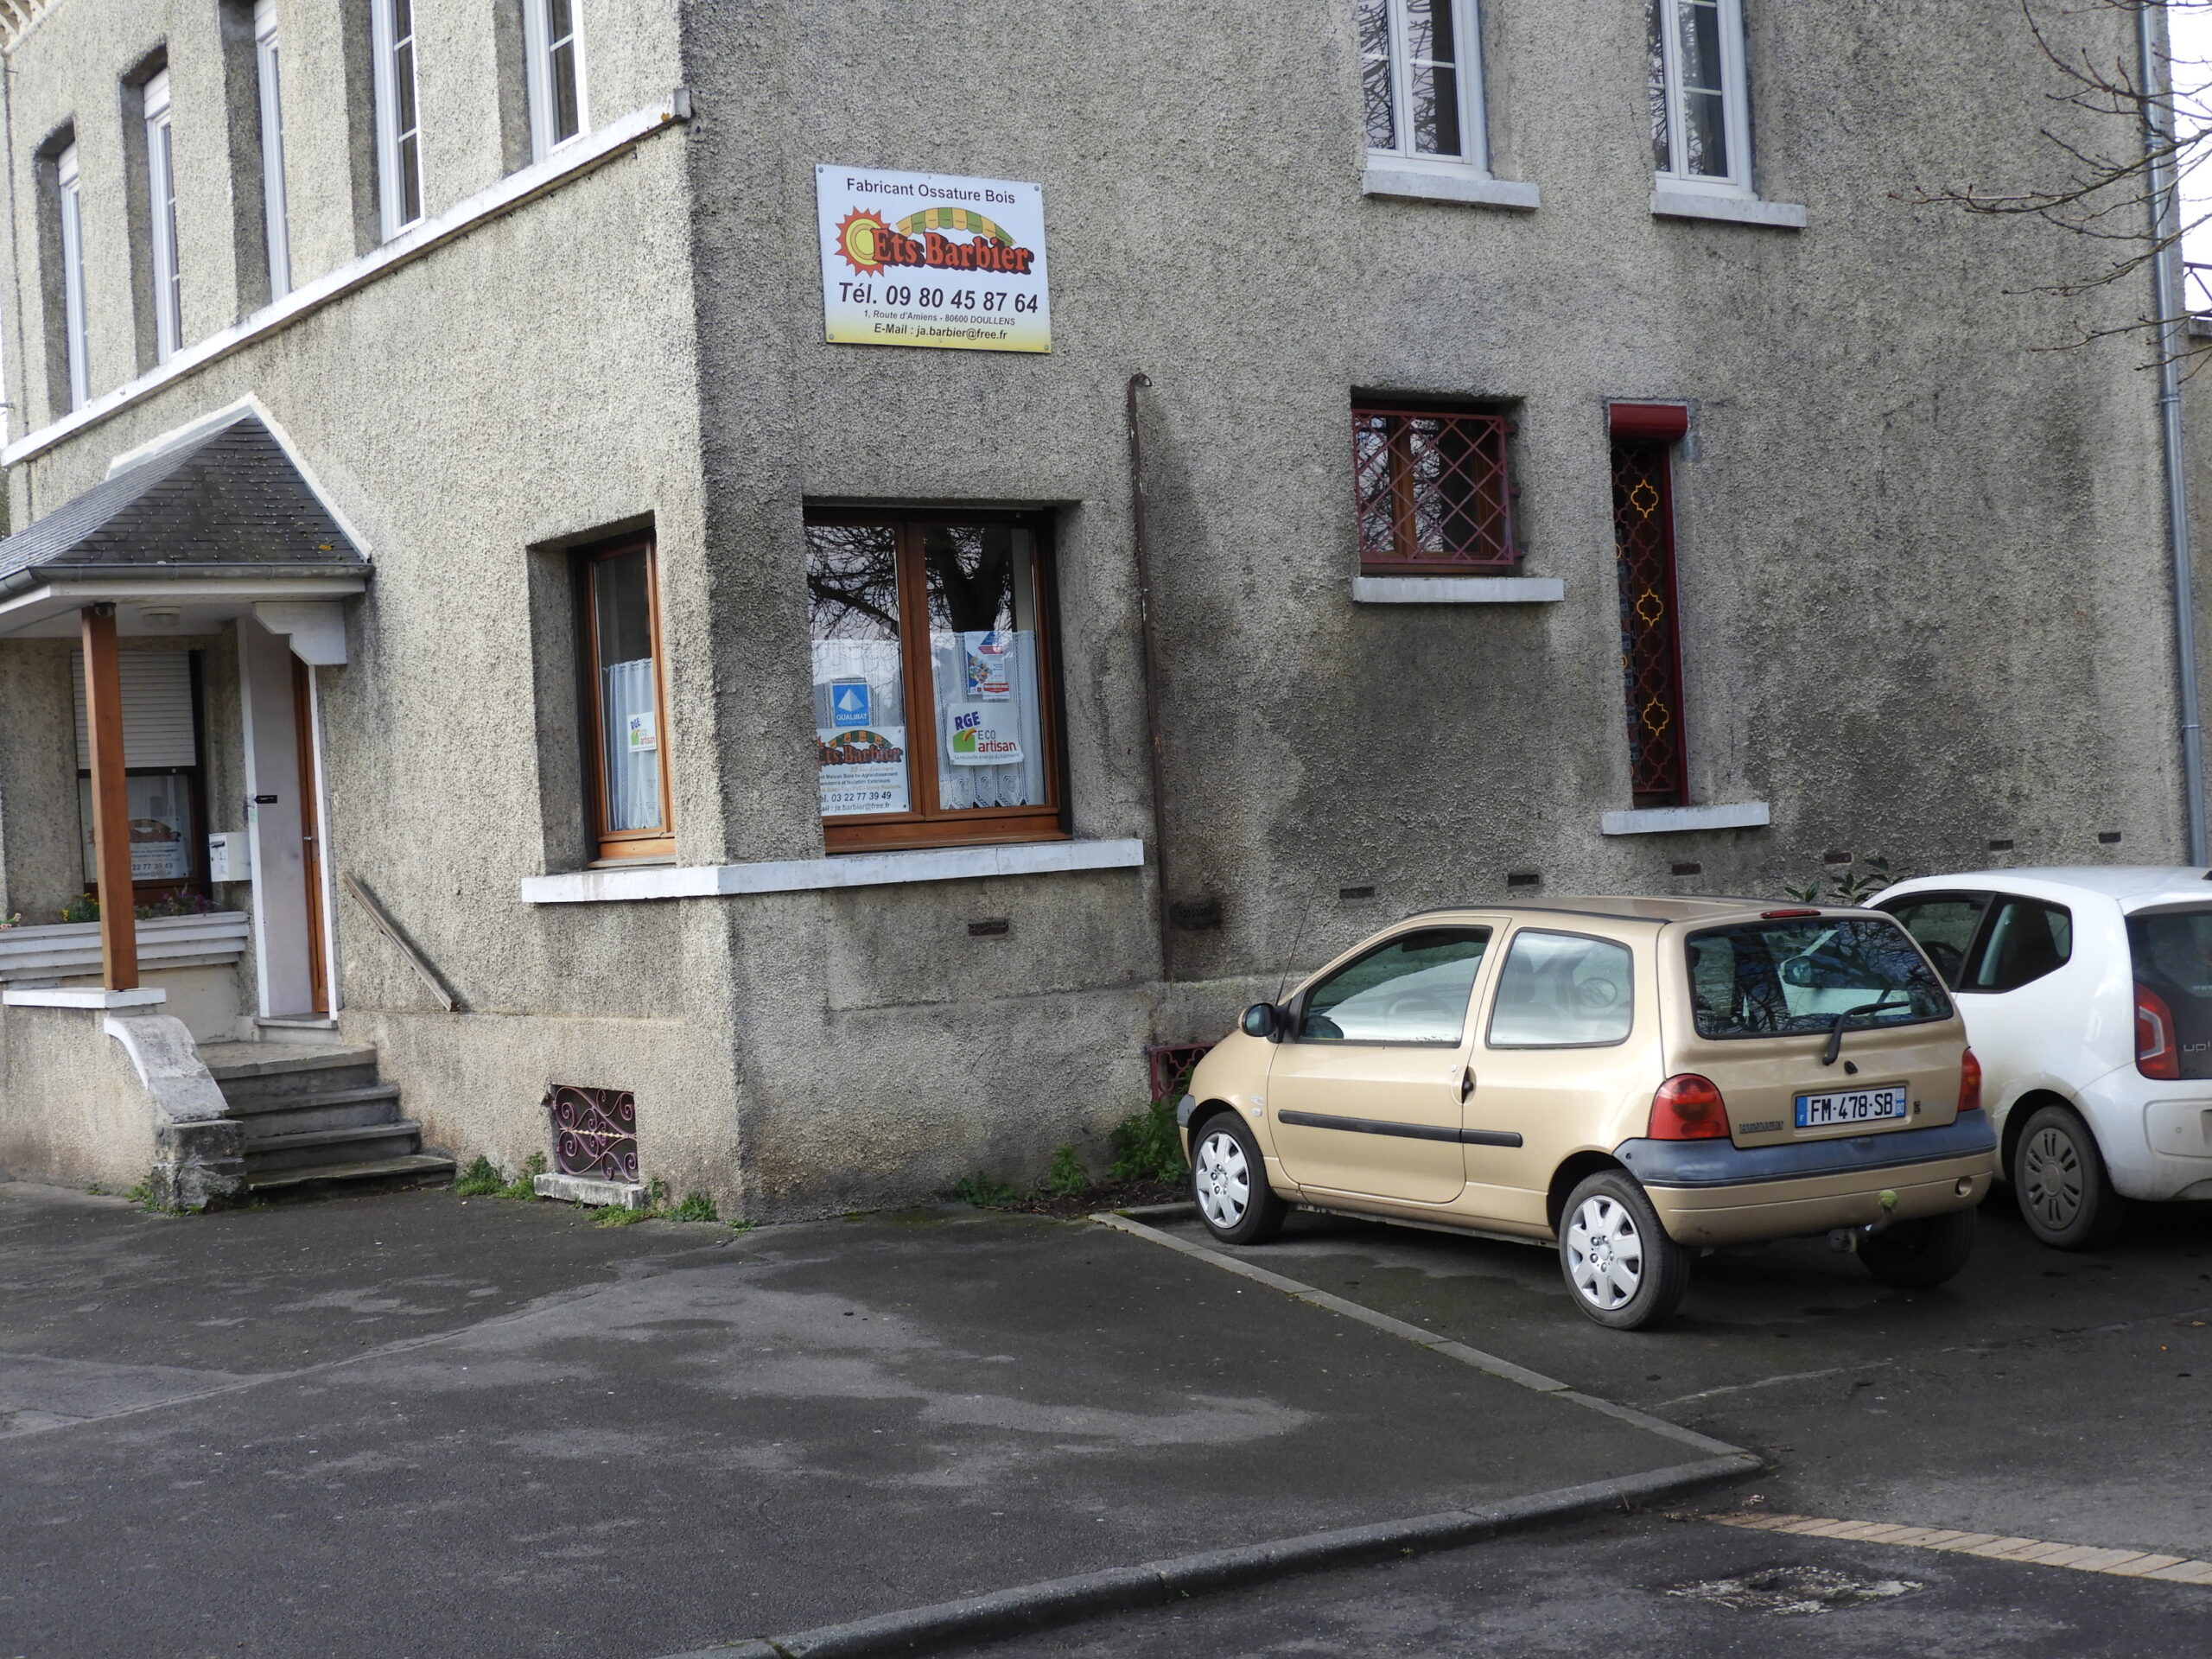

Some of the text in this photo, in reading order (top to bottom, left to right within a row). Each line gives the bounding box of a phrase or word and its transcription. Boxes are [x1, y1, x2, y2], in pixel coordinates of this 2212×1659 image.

[847, 178, 1015, 204] Fabricant Ossature Bois
[870, 228, 1033, 273] Ets Barbier
[839, 282, 1038, 314] Tél. 09 80 45 87 64
[864, 310, 871, 319] 1,
[873, 310, 898, 320] Route
[899, 312, 938, 321] d'Amiens
[944, 314, 969, 323] 80600
[970, 315, 1015, 326] DOULLENS
[874, 323, 907, 334] E-Mail
[916, 325, 1007, 340] ja.barbier@free.fr
[955, 711, 981, 731] RGE
[977, 730, 996, 740] ECO
[842, 744, 903, 765] Barbier
[978, 741, 1017, 753] artisan
[831, 793, 842, 803] 03
[844, 793, 855, 802] 22
[857, 792, 867, 801] 77
[869, 791, 880, 800] 39
[881, 791, 892, 799] 49
[835, 802, 891, 812] ja.barbier@free.fr
